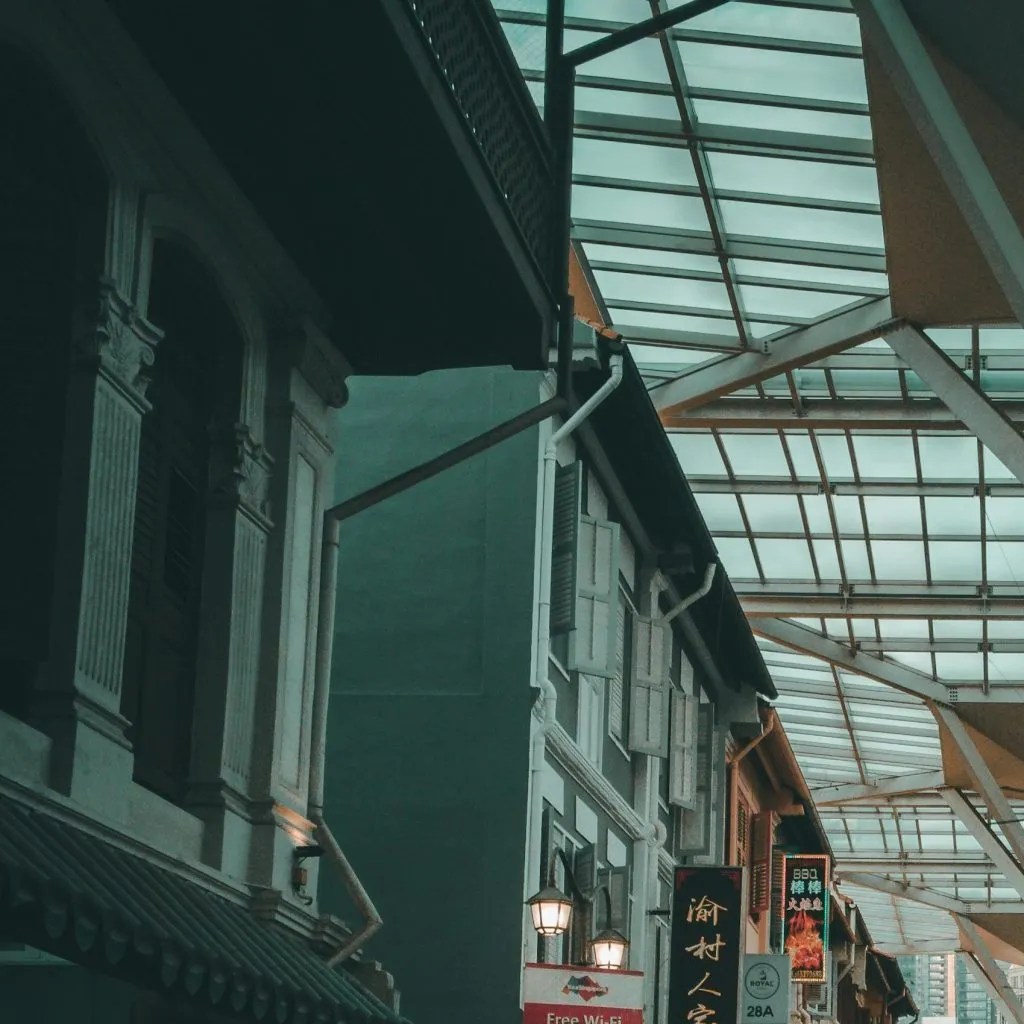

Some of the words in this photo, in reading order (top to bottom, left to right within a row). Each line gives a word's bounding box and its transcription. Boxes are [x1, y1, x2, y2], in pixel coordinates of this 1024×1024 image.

[793, 868, 818, 880] BBQ
[750, 980, 774, 988] ROYAL
[746, 1005, 774, 1018] 28A
